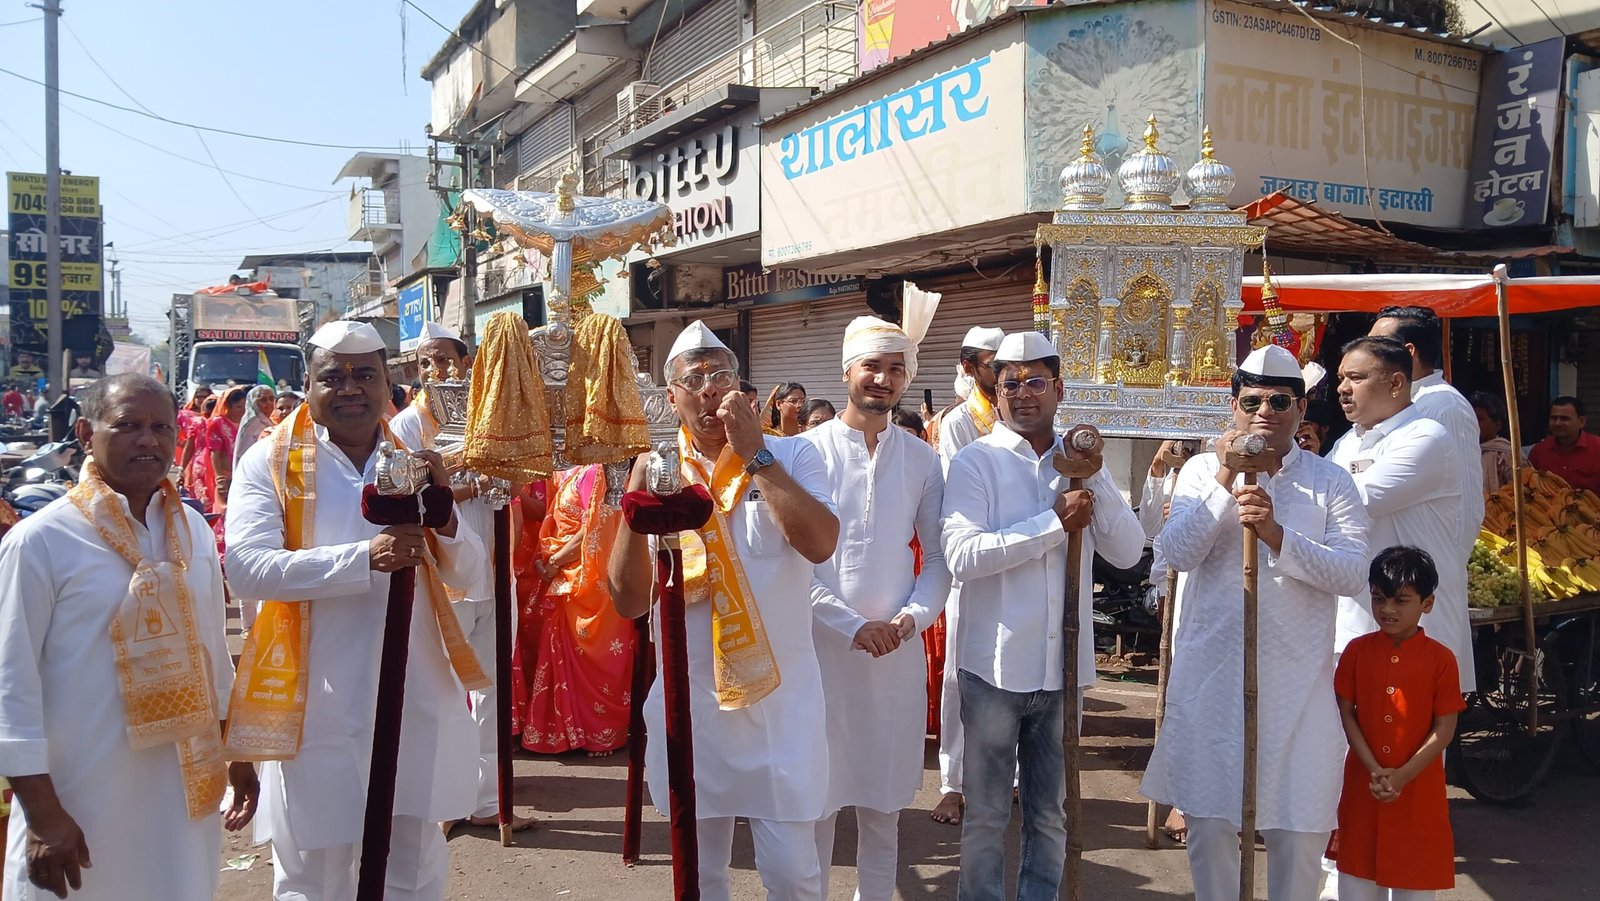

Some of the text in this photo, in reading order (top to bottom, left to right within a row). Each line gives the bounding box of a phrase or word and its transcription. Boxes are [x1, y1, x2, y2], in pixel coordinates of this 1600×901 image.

[1212, 9, 1242, 27] GSTIN:
[1414, 47, 1478, 72] M. 8007266795
[1473, 169, 1544, 202] होटल
[1378, 187, 1434, 213] इटारसी
[726, 269, 769, 300] Bittu
[199, 330, 223, 339] SAI
[244, 331, 297, 341] EVENTS
